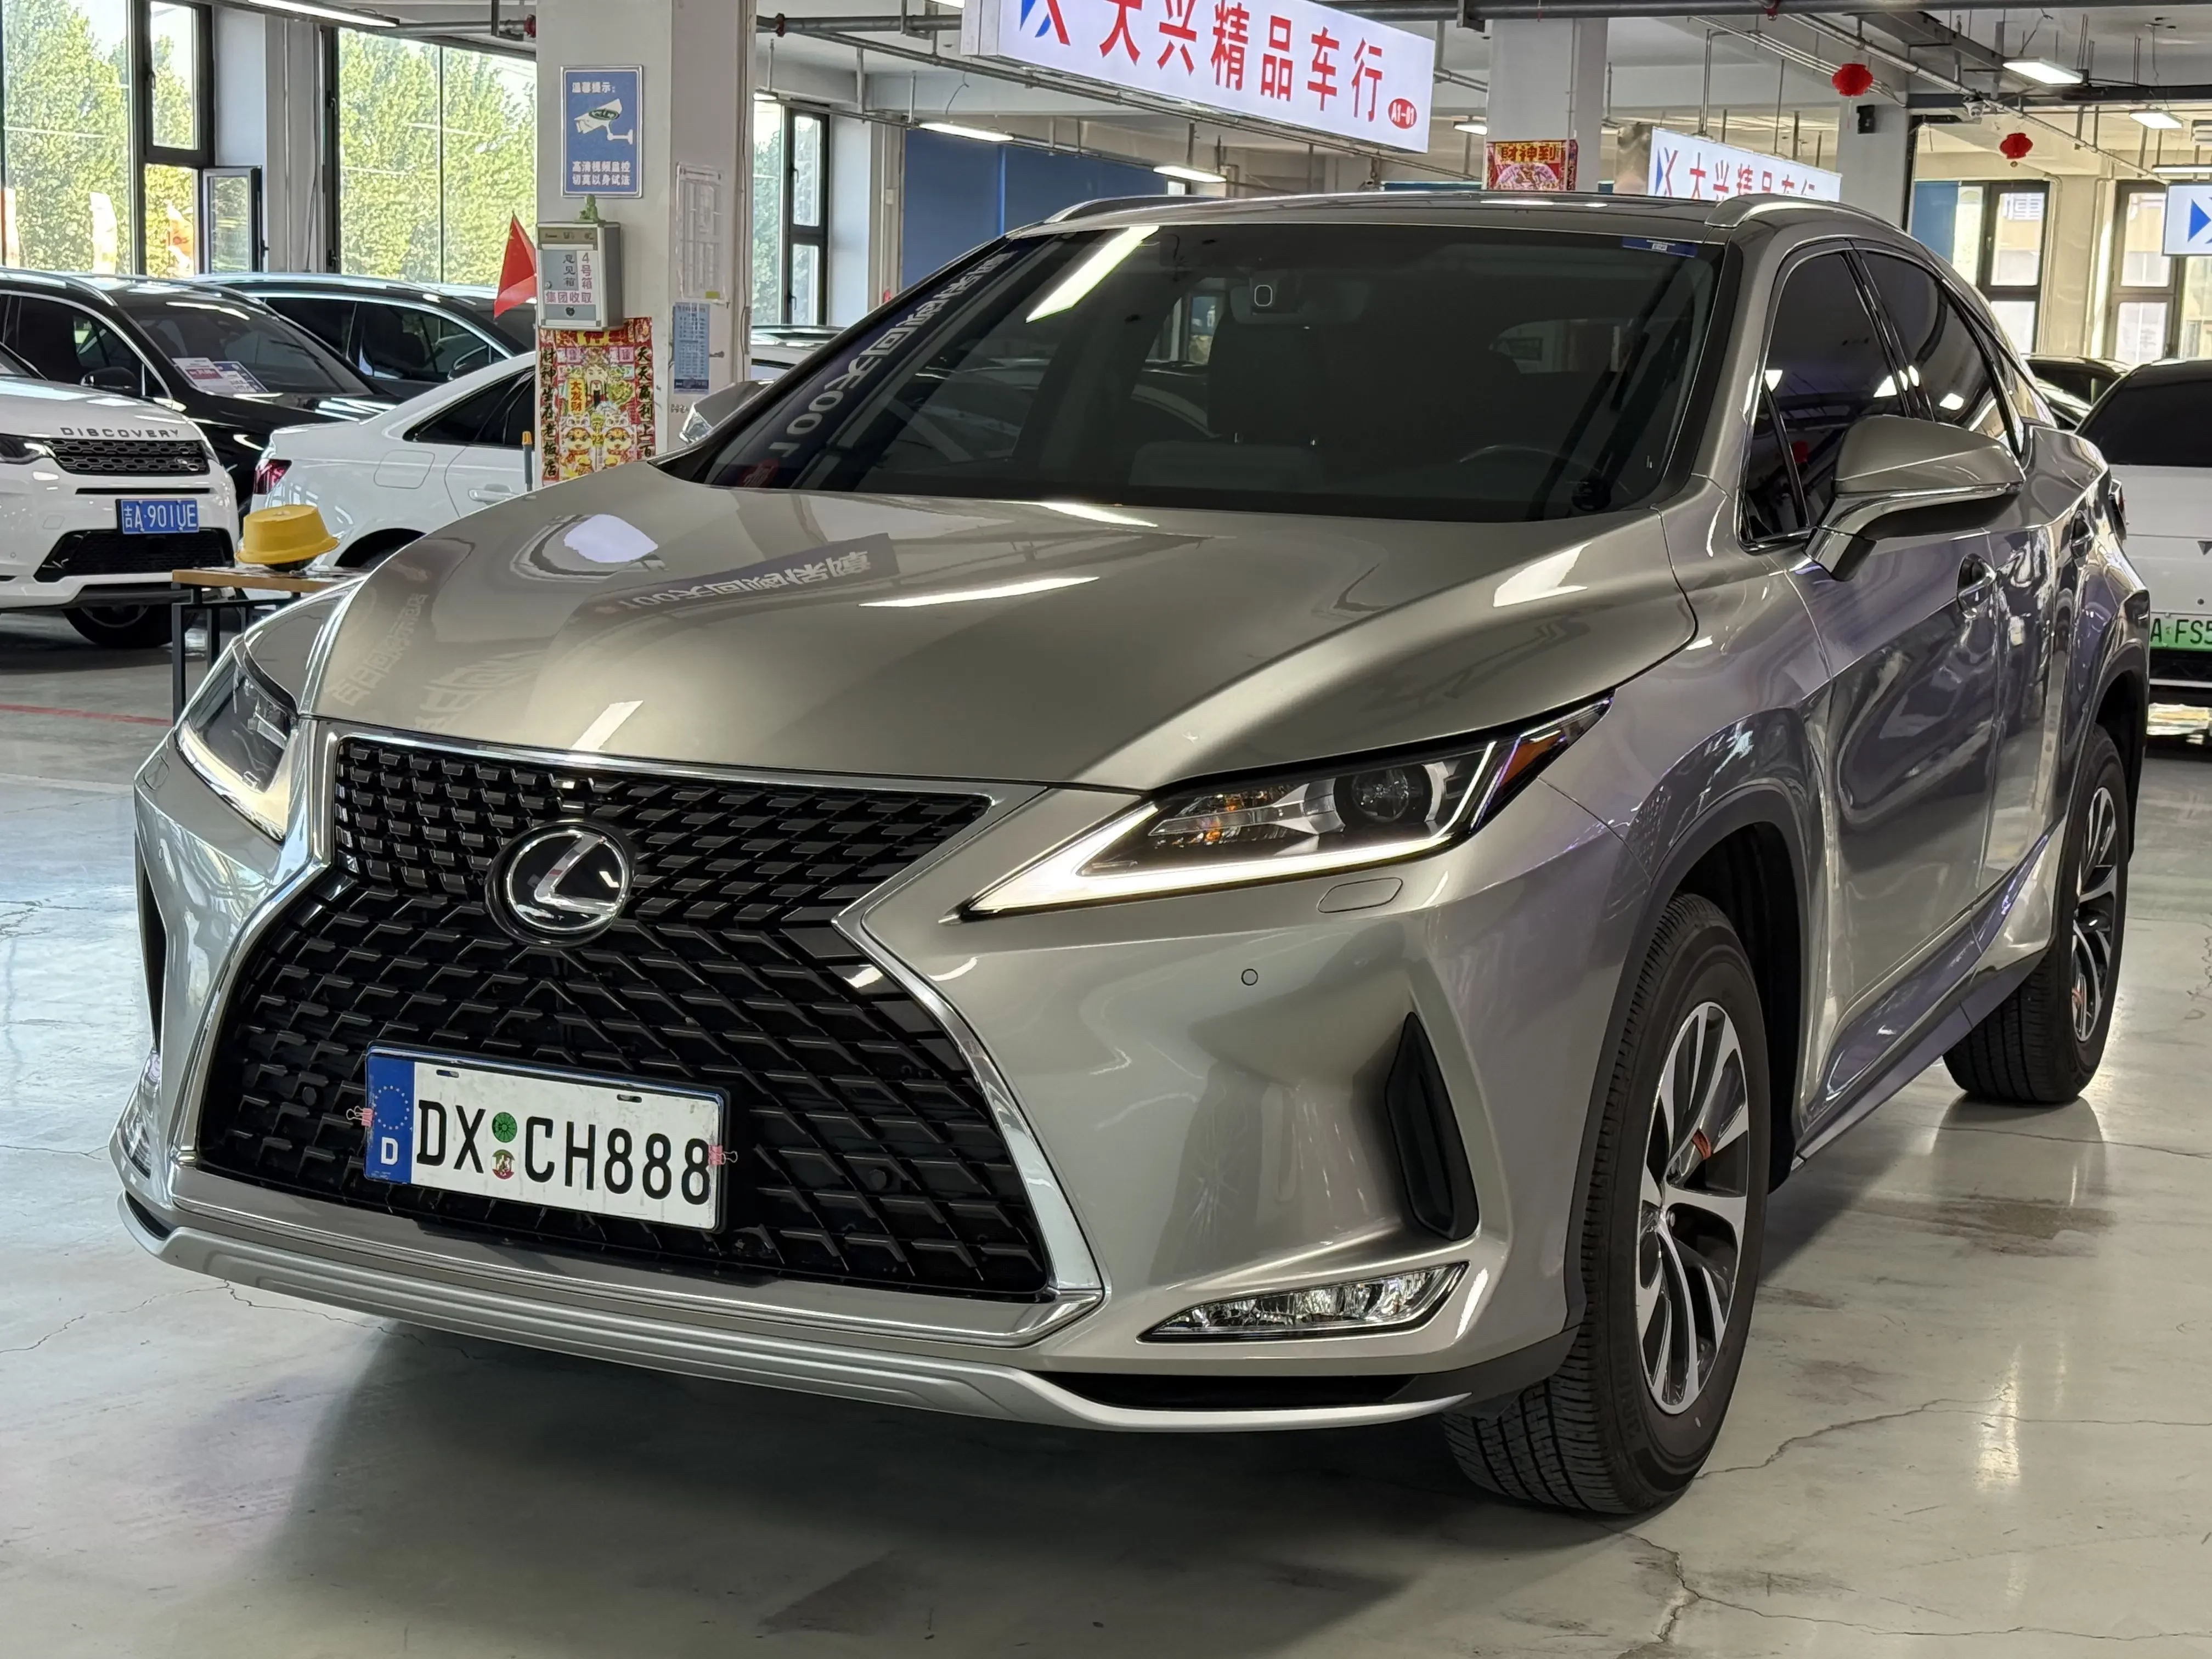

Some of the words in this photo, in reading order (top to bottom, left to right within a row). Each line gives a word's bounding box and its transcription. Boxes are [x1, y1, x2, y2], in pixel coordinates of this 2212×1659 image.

[1099, 0, 1383, 122] 大兴精品车行
[572, 161, 630, 172] 高清视频监控
[572, 174, 630, 186] 切莫以身试法
[581, 252, 592, 289] 4号箱
[545, 292, 592, 303] 集团收取
[60, 427, 178, 438] DISCOVERY
[381, 1137, 398, 1166] D
[416, 1099, 486, 1175] DX
[524, 1116, 710, 1205] CH888
